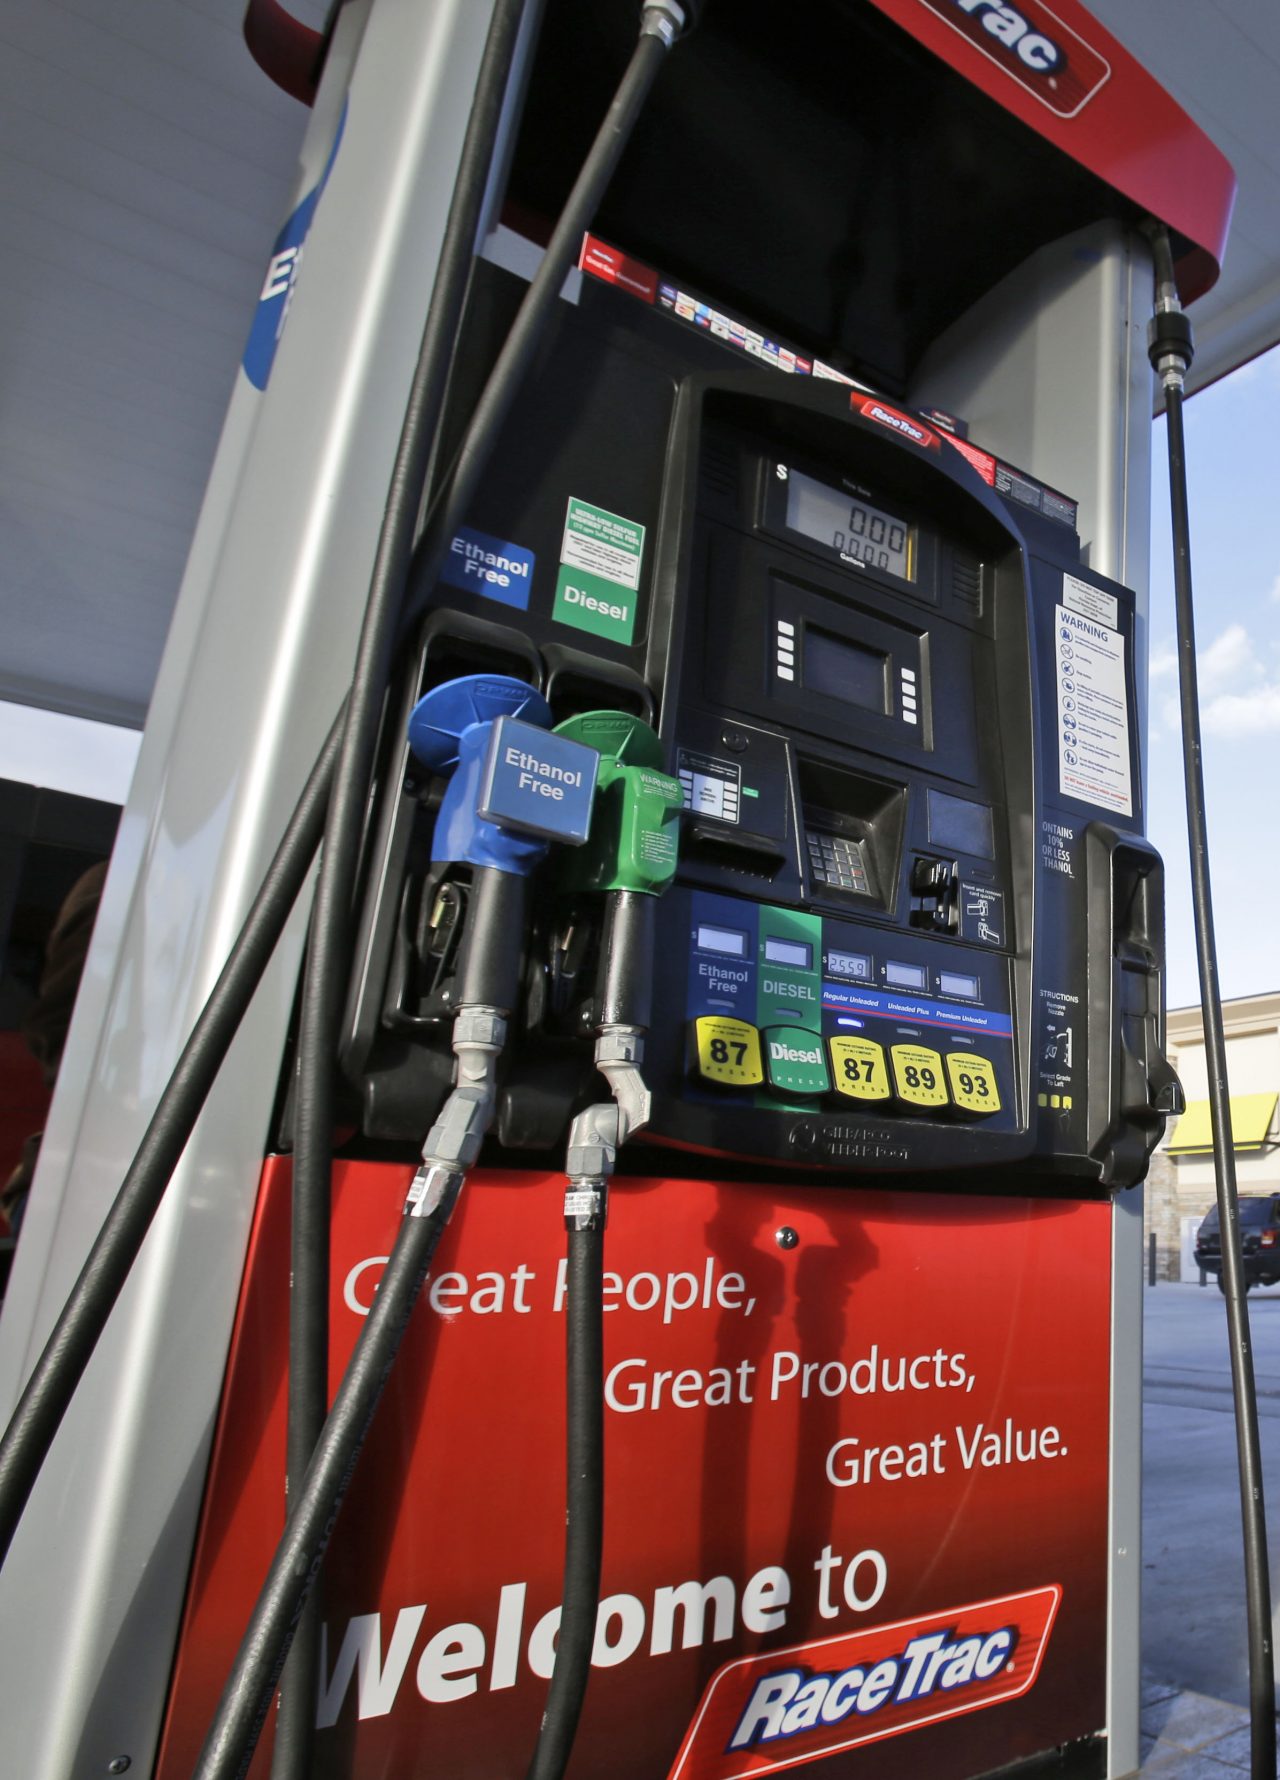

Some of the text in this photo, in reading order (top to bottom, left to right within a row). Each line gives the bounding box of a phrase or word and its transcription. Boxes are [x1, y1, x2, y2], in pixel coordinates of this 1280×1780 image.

[957, 0, 1057, 70] rac
[870, 407, 924, 440] RaceTrac
[776, 464, 788, 480] $
[451, 537, 529, 577] Ethanol
[465, 560, 511, 588] Free
[563, 585, 628, 621] Diesel
[1060, 611, 1109, 642] WARNING
[505, 747, 582, 788] Ethanol
[519, 772, 564, 801] Free
[640, 773, 678, 793] WARNING
[1042, 821, 1073, 840] ONTAINS
[1048, 834, 1063, 848] 10%
[1042, 844, 1070, 861] OR LESS
[1043, 856, 1072, 875] THANOL
[698, 963, 748, 983] Ethanol
[709, 979, 738, 993] Free
[763, 980, 816, 1000] DIESEL
[1040, 989, 1079, 1004] STRUCTIONS
[823, 991, 879, 1007] Regular Unleaded
[888, 1003, 930, 1016] Unleaded Plus
[936, 1010, 988, 1025] Premium Unleaded
[710, 1038, 748, 1067] 87
[770, 1042, 822, 1064] Diesel
[843, 1057, 875, 1083] 87
[904, 1065, 936, 1090] 89
[959, 1073, 989, 1097] 93
[344, 1256, 534, 1317] Geat
[604, 1344, 977, 1414] Great Products,
[825, 1418, 1069, 1488] Great Value.
[315, 1544, 888, 1730] Welcome to
[729, 1627, 1011, 1752] RaceTrac
